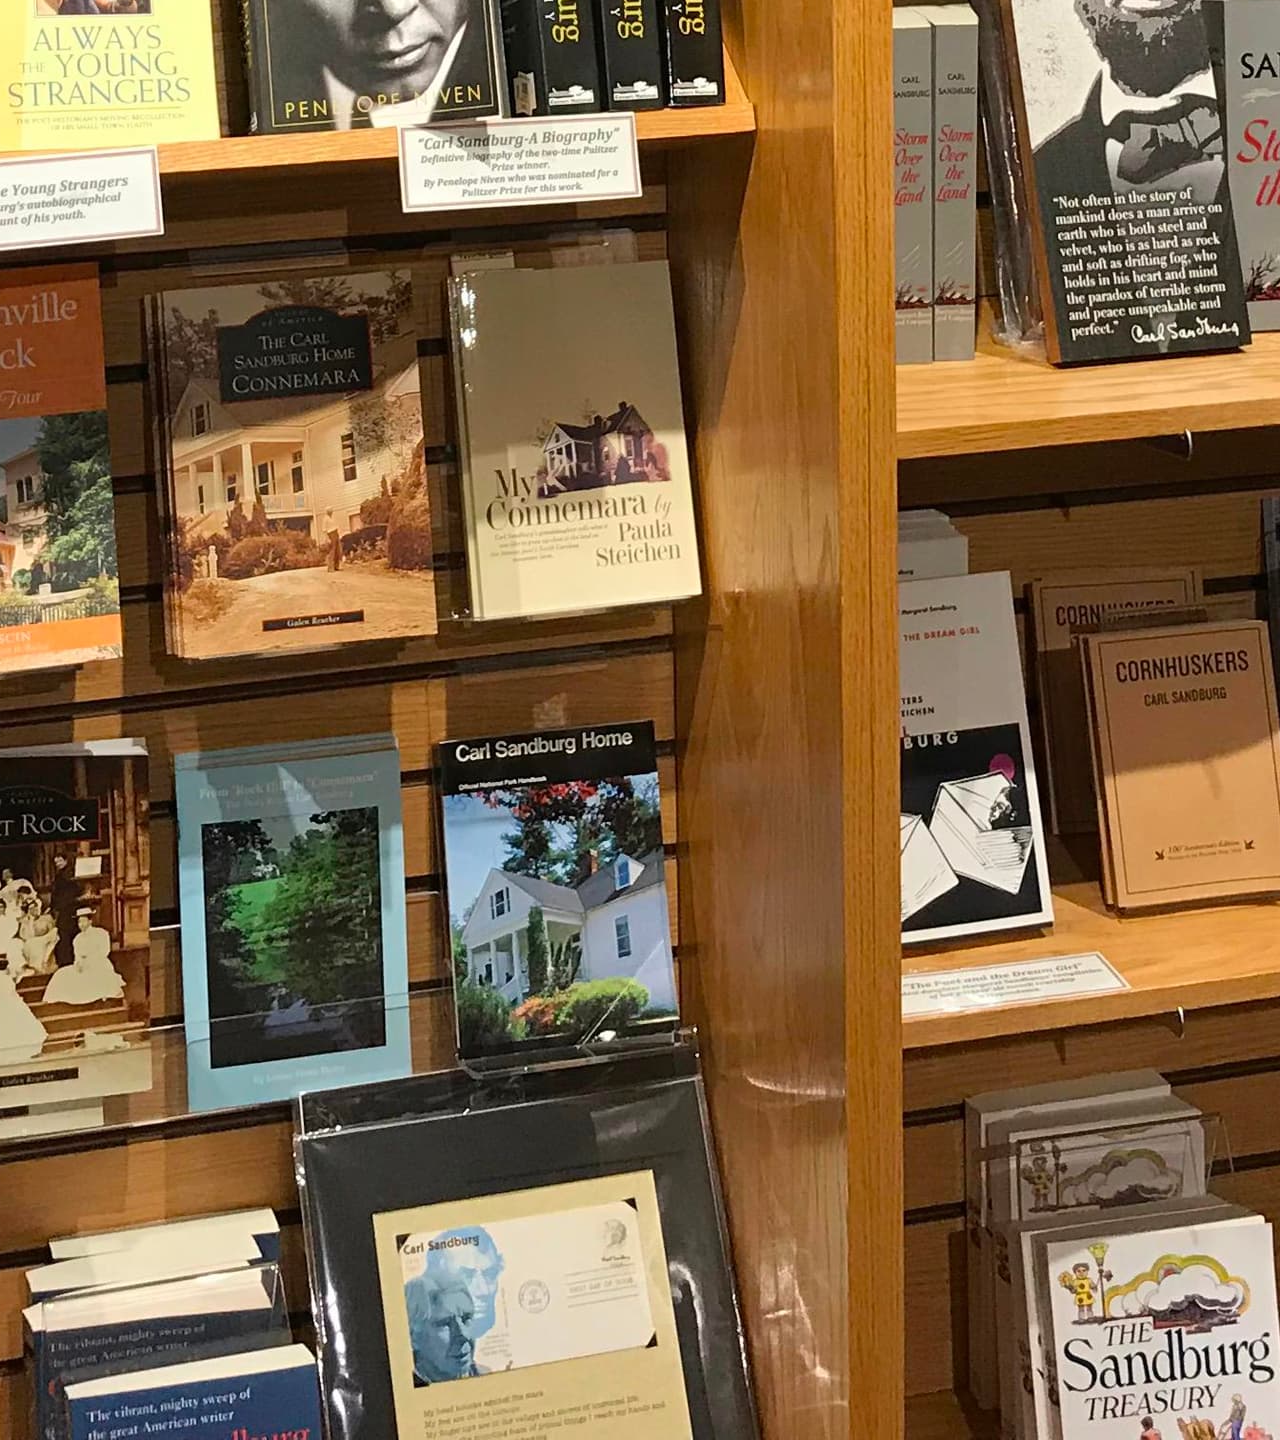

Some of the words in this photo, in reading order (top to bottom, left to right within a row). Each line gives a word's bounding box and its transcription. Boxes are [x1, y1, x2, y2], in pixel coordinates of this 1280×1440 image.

[33, 25, 162, 52] ALWAYS
[19, 62, 46, 74] THE
[56, 52, 177, 77] YOUNG
[9, 78, 190, 108] STRANGERS
[12, 182, 56, 197] Young
[59, 176, 128, 192] Strangers
[495, 468, 537, 503] My
[487, 495, 646, 530] Connemara
[654, 494, 672, 520] by
[619, 519, 672, 542] Paula
[596, 543, 681, 567] Steichen
[1115, 650, 1249, 683] CORNHUSKERS
[1143, 690, 1169, 706] CARL
[1172, 686, 1227, 704] SANDBURG
[455, 742, 490, 762] Carl
[495, 737, 575, 759] Sandburg
[582, 730, 633, 748] Home
[1104, 1321, 1156, 1346] THE
[1063, 1329, 1274, 1392] Sandburg
[1085, 1384, 1221, 1421] TREASURY
